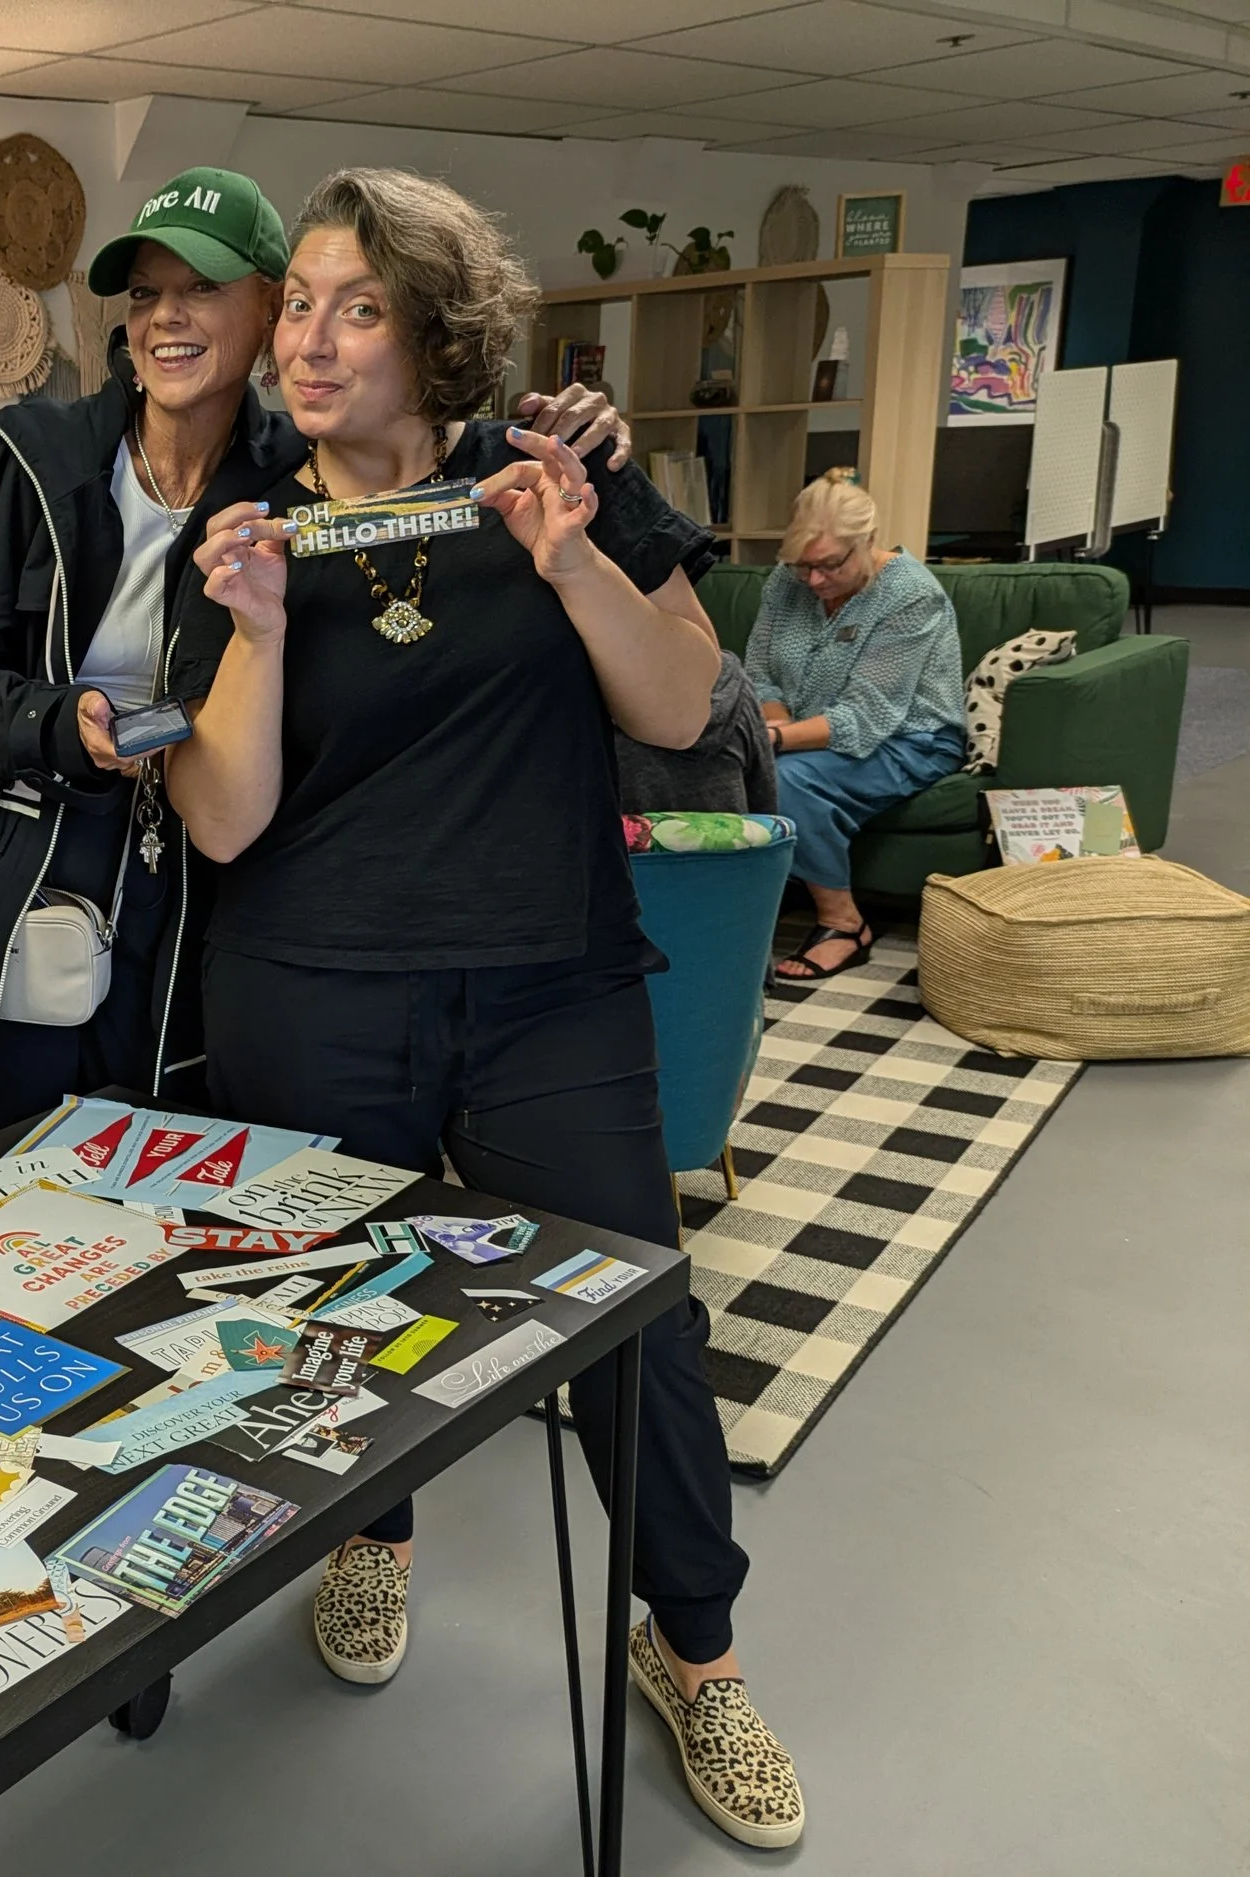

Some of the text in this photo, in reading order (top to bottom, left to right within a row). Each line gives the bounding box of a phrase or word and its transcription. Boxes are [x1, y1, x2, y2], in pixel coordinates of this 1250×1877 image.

[184, 186, 221, 214] All
[293, 503, 335, 526] OH,
[297, 506, 472, 553] HELLO THERE!
[147, 1133, 184, 1157] YOUR
[15, 1160, 49, 1175] in
[197, 1161, 233, 1184] Tale
[229, 1173, 309, 1207] on the
[239, 1168, 365, 1226] brink
[312, 1168, 406, 1221] NEW
[168, 1228, 320, 1251] STAY
[370, 1223, 426, 1252] H
[462, 1216, 521, 1233] CREATIVE
[14, 1236, 85, 1275] GREAT
[18, 1240, 51, 1258] ALL
[22, 1235, 128, 1292] CHANGES
[65, 1248, 176, 1310] PRECEDED BY
[80, 1261, 120, 1283] ARE
[195, 1260, 310, 1283] take the reins
[577, 1268, 639, 1302] Find YOUR
[121, 1304, 223, 1343] PERSONAL FINANCE
[365, 1308, 406, 1330] POP
[292, 1331, 334, 1382] Imagine
[339, 1336, 368, 1358] life
[40, 1360, 98, 1393] ON
[331, 1358, 358, 1390] your
[440, 1356, 511, 1393] Life
[132, 1390, 243, 1442] DISCOVER YOUR
[111, 1407, 240, 1471] NEXT GREAT
[33, 1494, 62, 1519] Ground
[152, 1468, 238, 1542] EDGE
[102, 1548, 124, 1572] Greetings
[112, 1529, 193, 1594] THE
